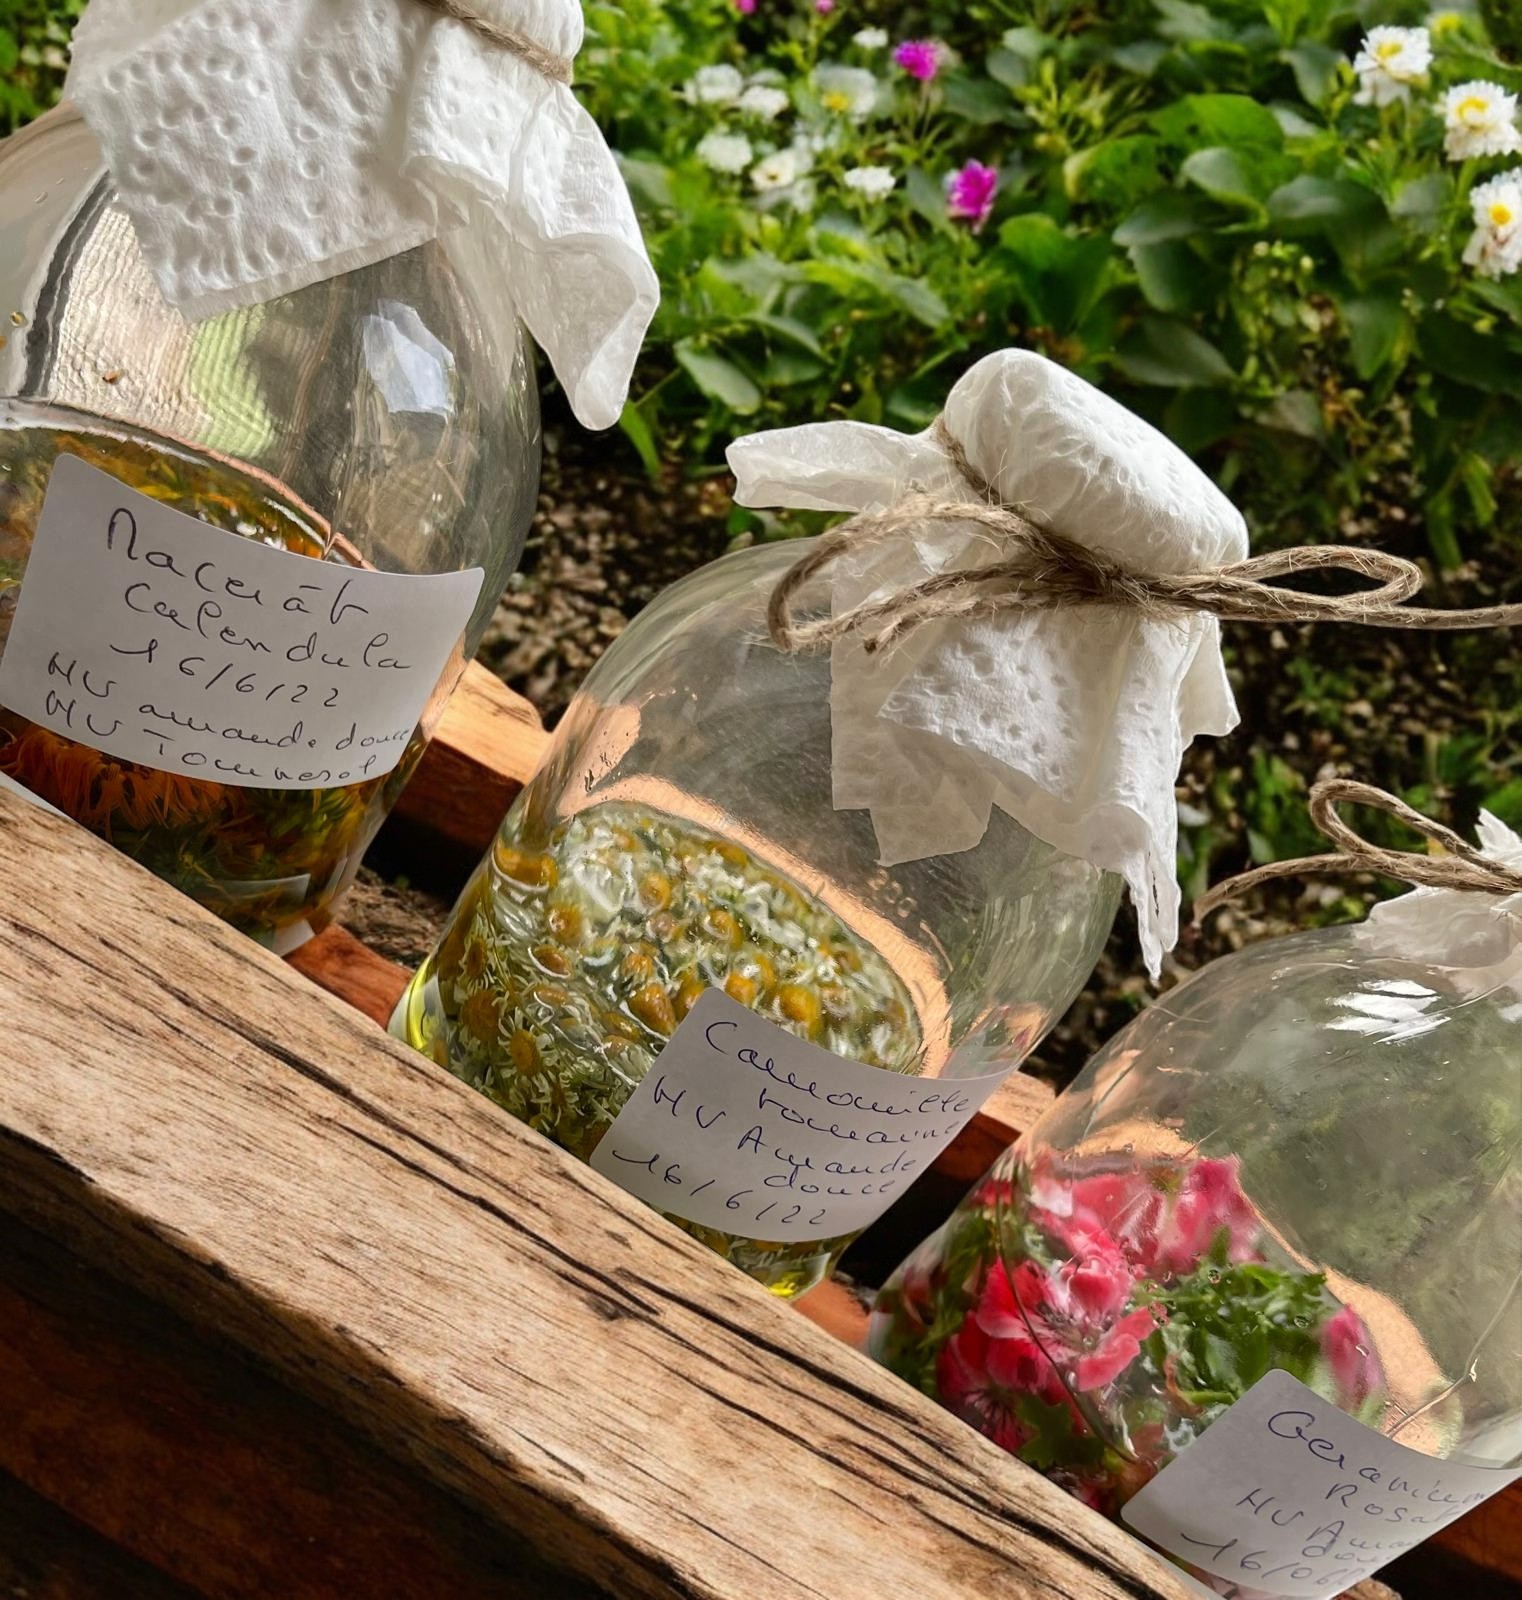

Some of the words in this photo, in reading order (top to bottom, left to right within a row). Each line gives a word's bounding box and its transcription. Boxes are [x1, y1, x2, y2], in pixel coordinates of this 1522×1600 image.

[125, 582, 412, 670] Calendula
[110, 639, 339, 708] 16/6/22
[139, 702, 317, 749] amande
[144, 728, 376, 782] Tournesol
[706, 1021, 971, 1115] Camomille
[738, 1125, 917, 1175] Amande
[764, 1165, 893, 1195] douce
[612, 1149, 824, 1225] 16/6/22
